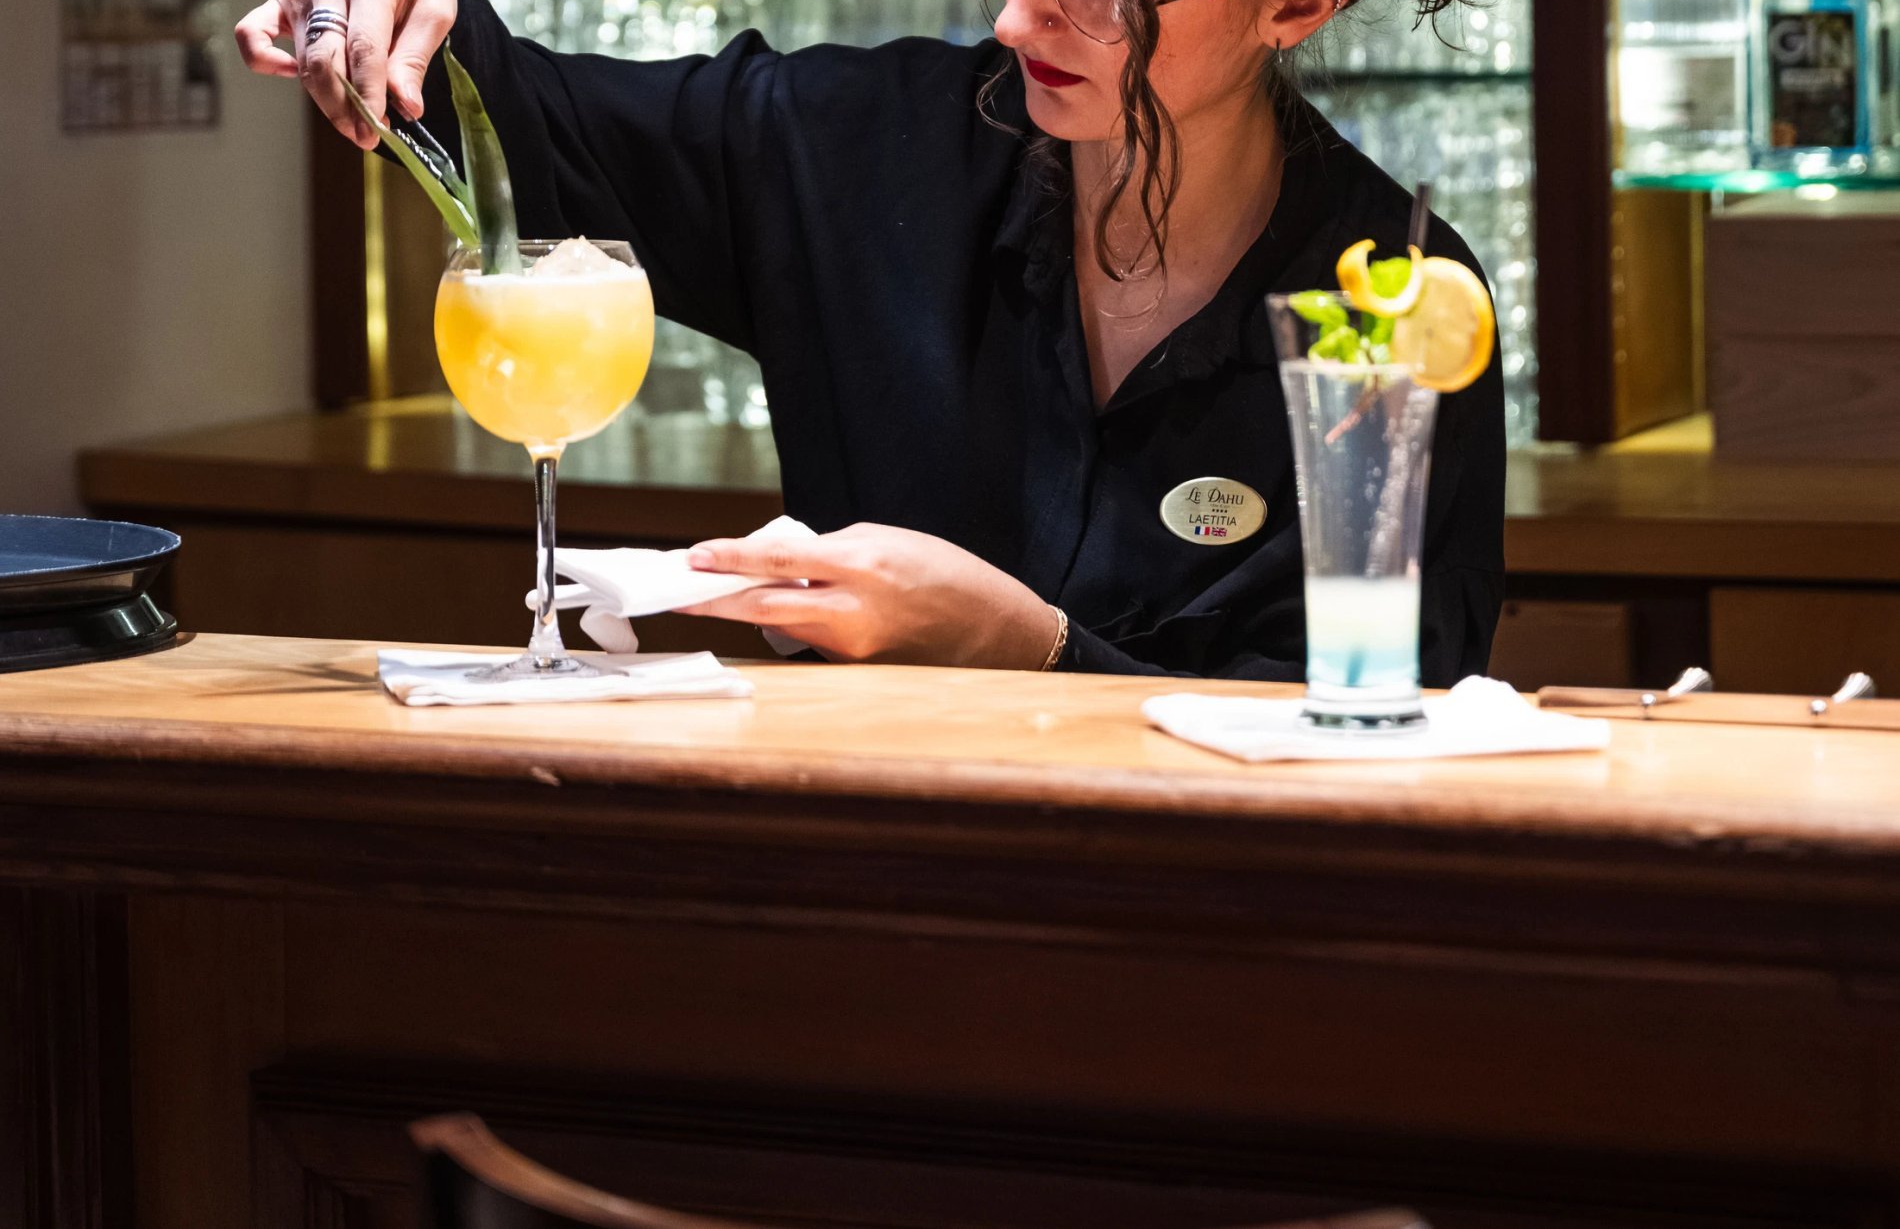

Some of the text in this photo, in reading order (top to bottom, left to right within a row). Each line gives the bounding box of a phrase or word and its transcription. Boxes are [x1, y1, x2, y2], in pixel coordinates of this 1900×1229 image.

[1769, 19, 1851, 67] GIN
[1186, 486, 1244, 505] LE DAHU
[1189, 514, 1237, 526] LAETITIA
